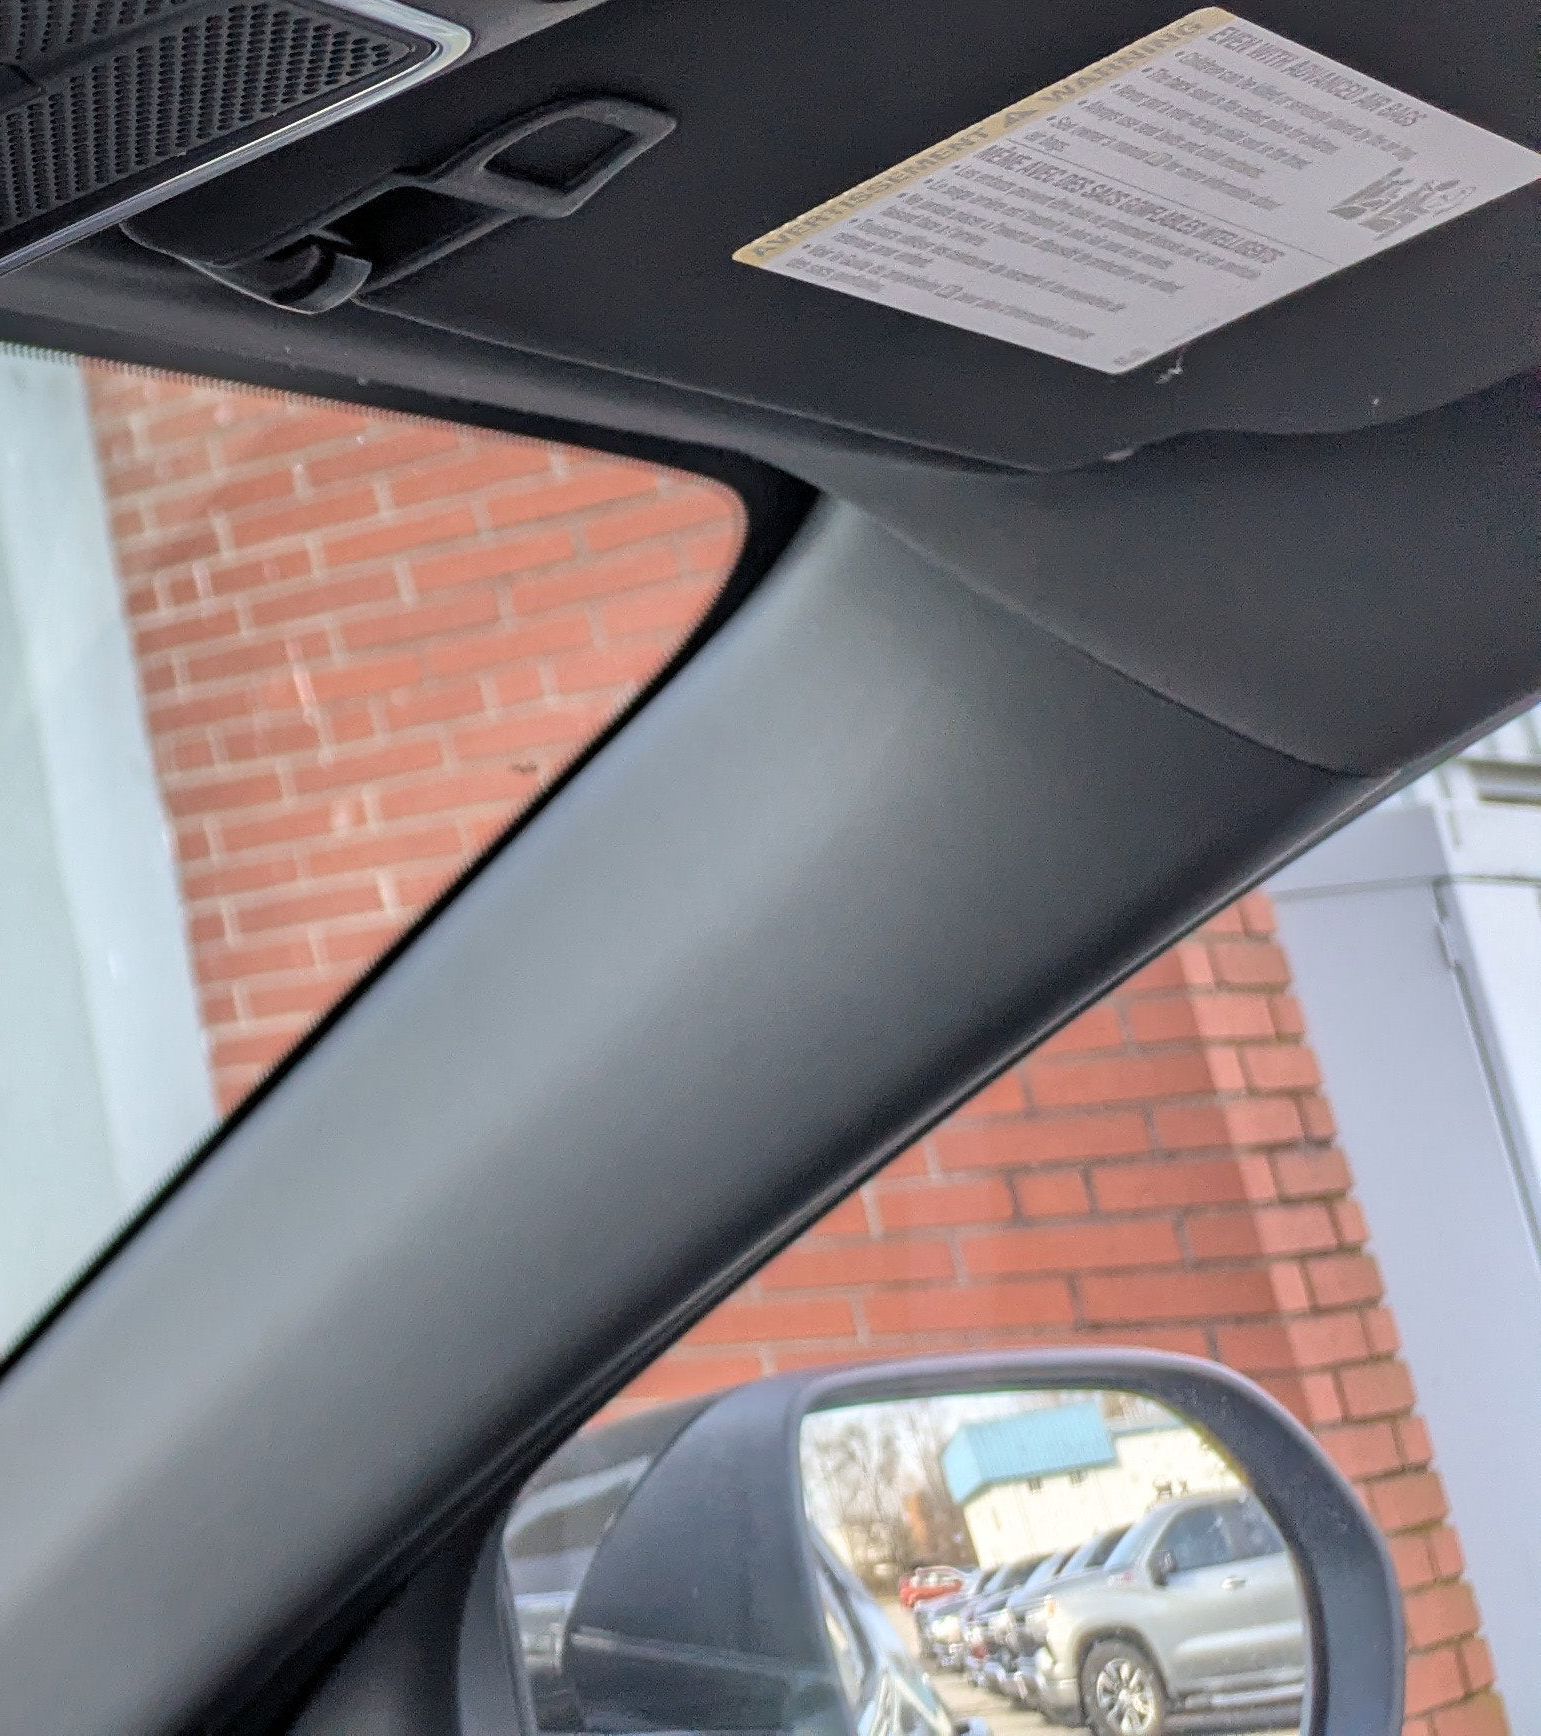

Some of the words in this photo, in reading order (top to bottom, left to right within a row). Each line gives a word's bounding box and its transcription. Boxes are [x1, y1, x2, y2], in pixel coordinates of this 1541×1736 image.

[1041, 22, 1203, 102] WARNING
[1207, 27, 1263, 53] EVEN
[1247, 43, 1299, 69] WITH
[1281, 61, 1368, 100] ADVANCED
[1351, 93, 1392, 112] AIR
[1377, 103, 1427, 127] BAGS
[753, 129, 987, 257] AVERTISSEMENT
[975, 145, 1032, 170] MÊME
[1016, 161, 1067, 183] AVEC
[1053, 174, 1095, 193] DES
[1081, 184, 1130, 206] SACS
[1118, 198, 1206, 235] GONFLABLES
[1194, 226, 1284, 263] INTELLIGENTS
